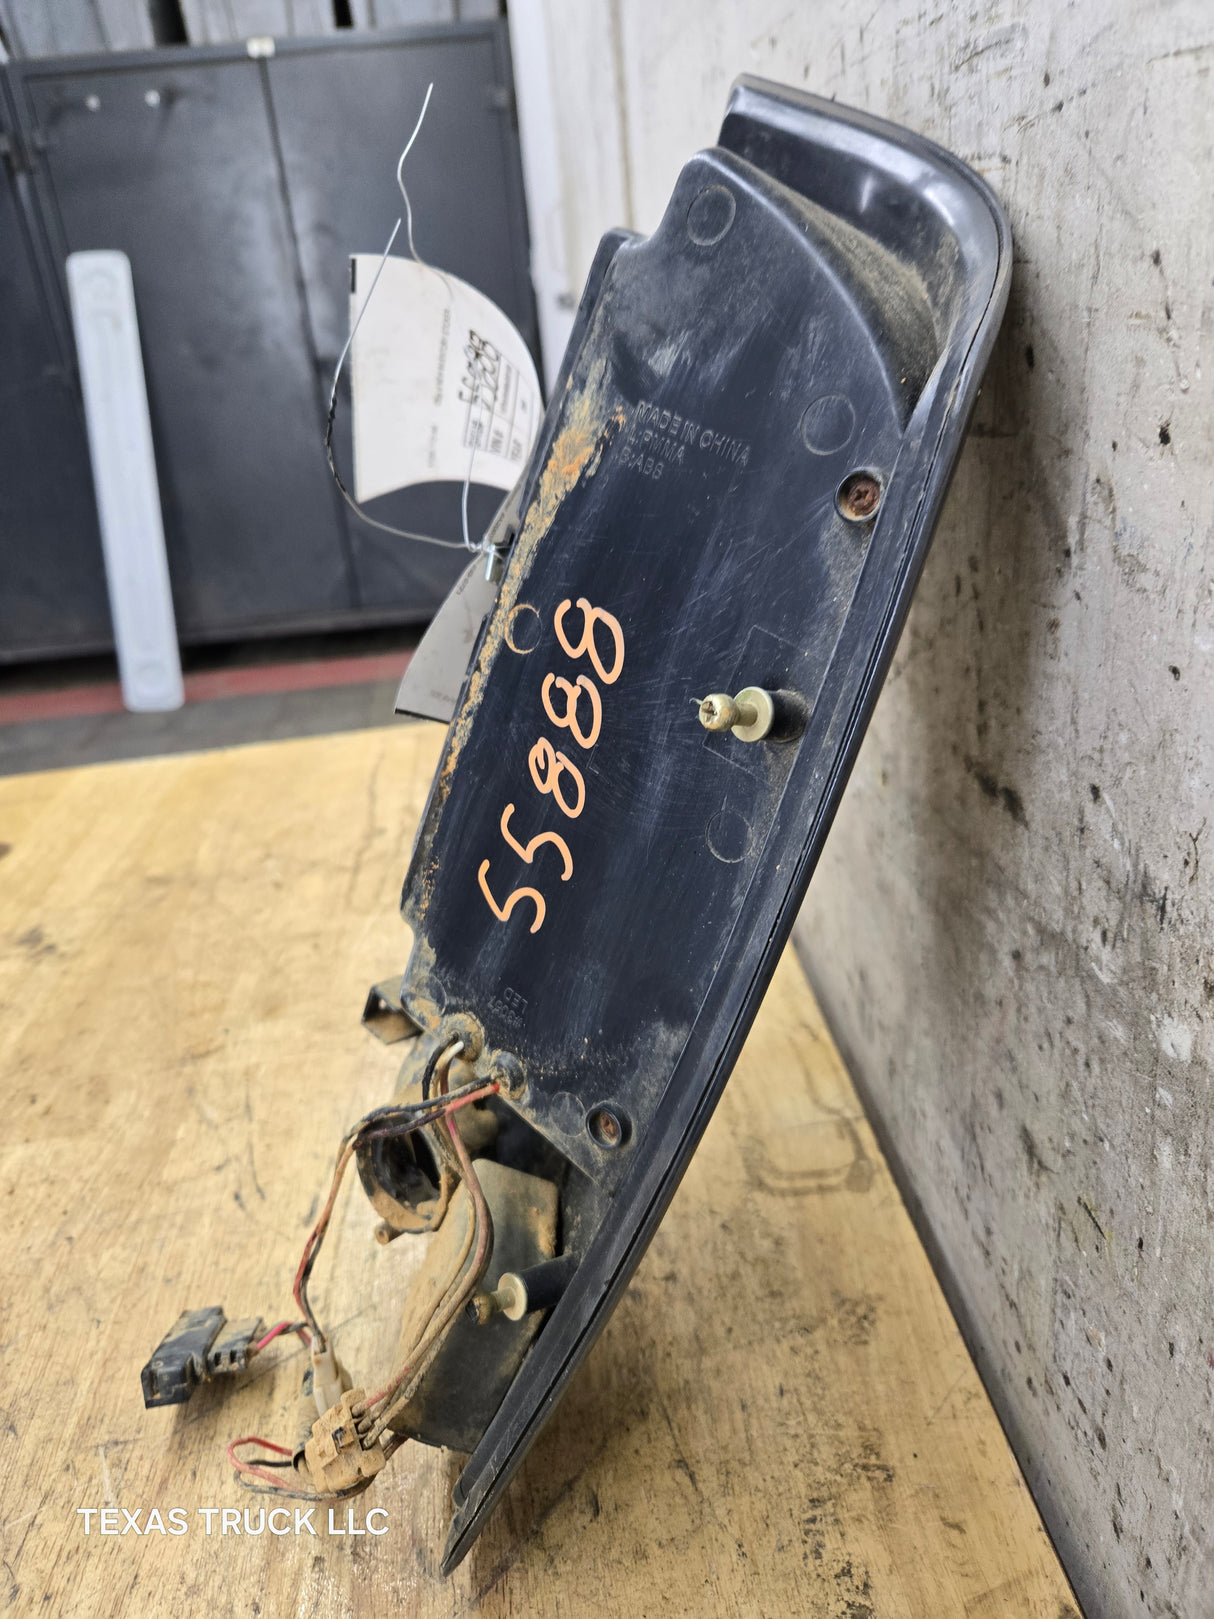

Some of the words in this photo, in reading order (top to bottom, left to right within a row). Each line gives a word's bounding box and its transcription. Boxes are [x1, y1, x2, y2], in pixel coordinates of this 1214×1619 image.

[635, 400, 682, 435] MADE
[680, 420, 700, 445] IN
[700, 429, 751, 467] CHINA
[478, 597, 625, 935] 55888
[503, 986, 528, 1015] LED
